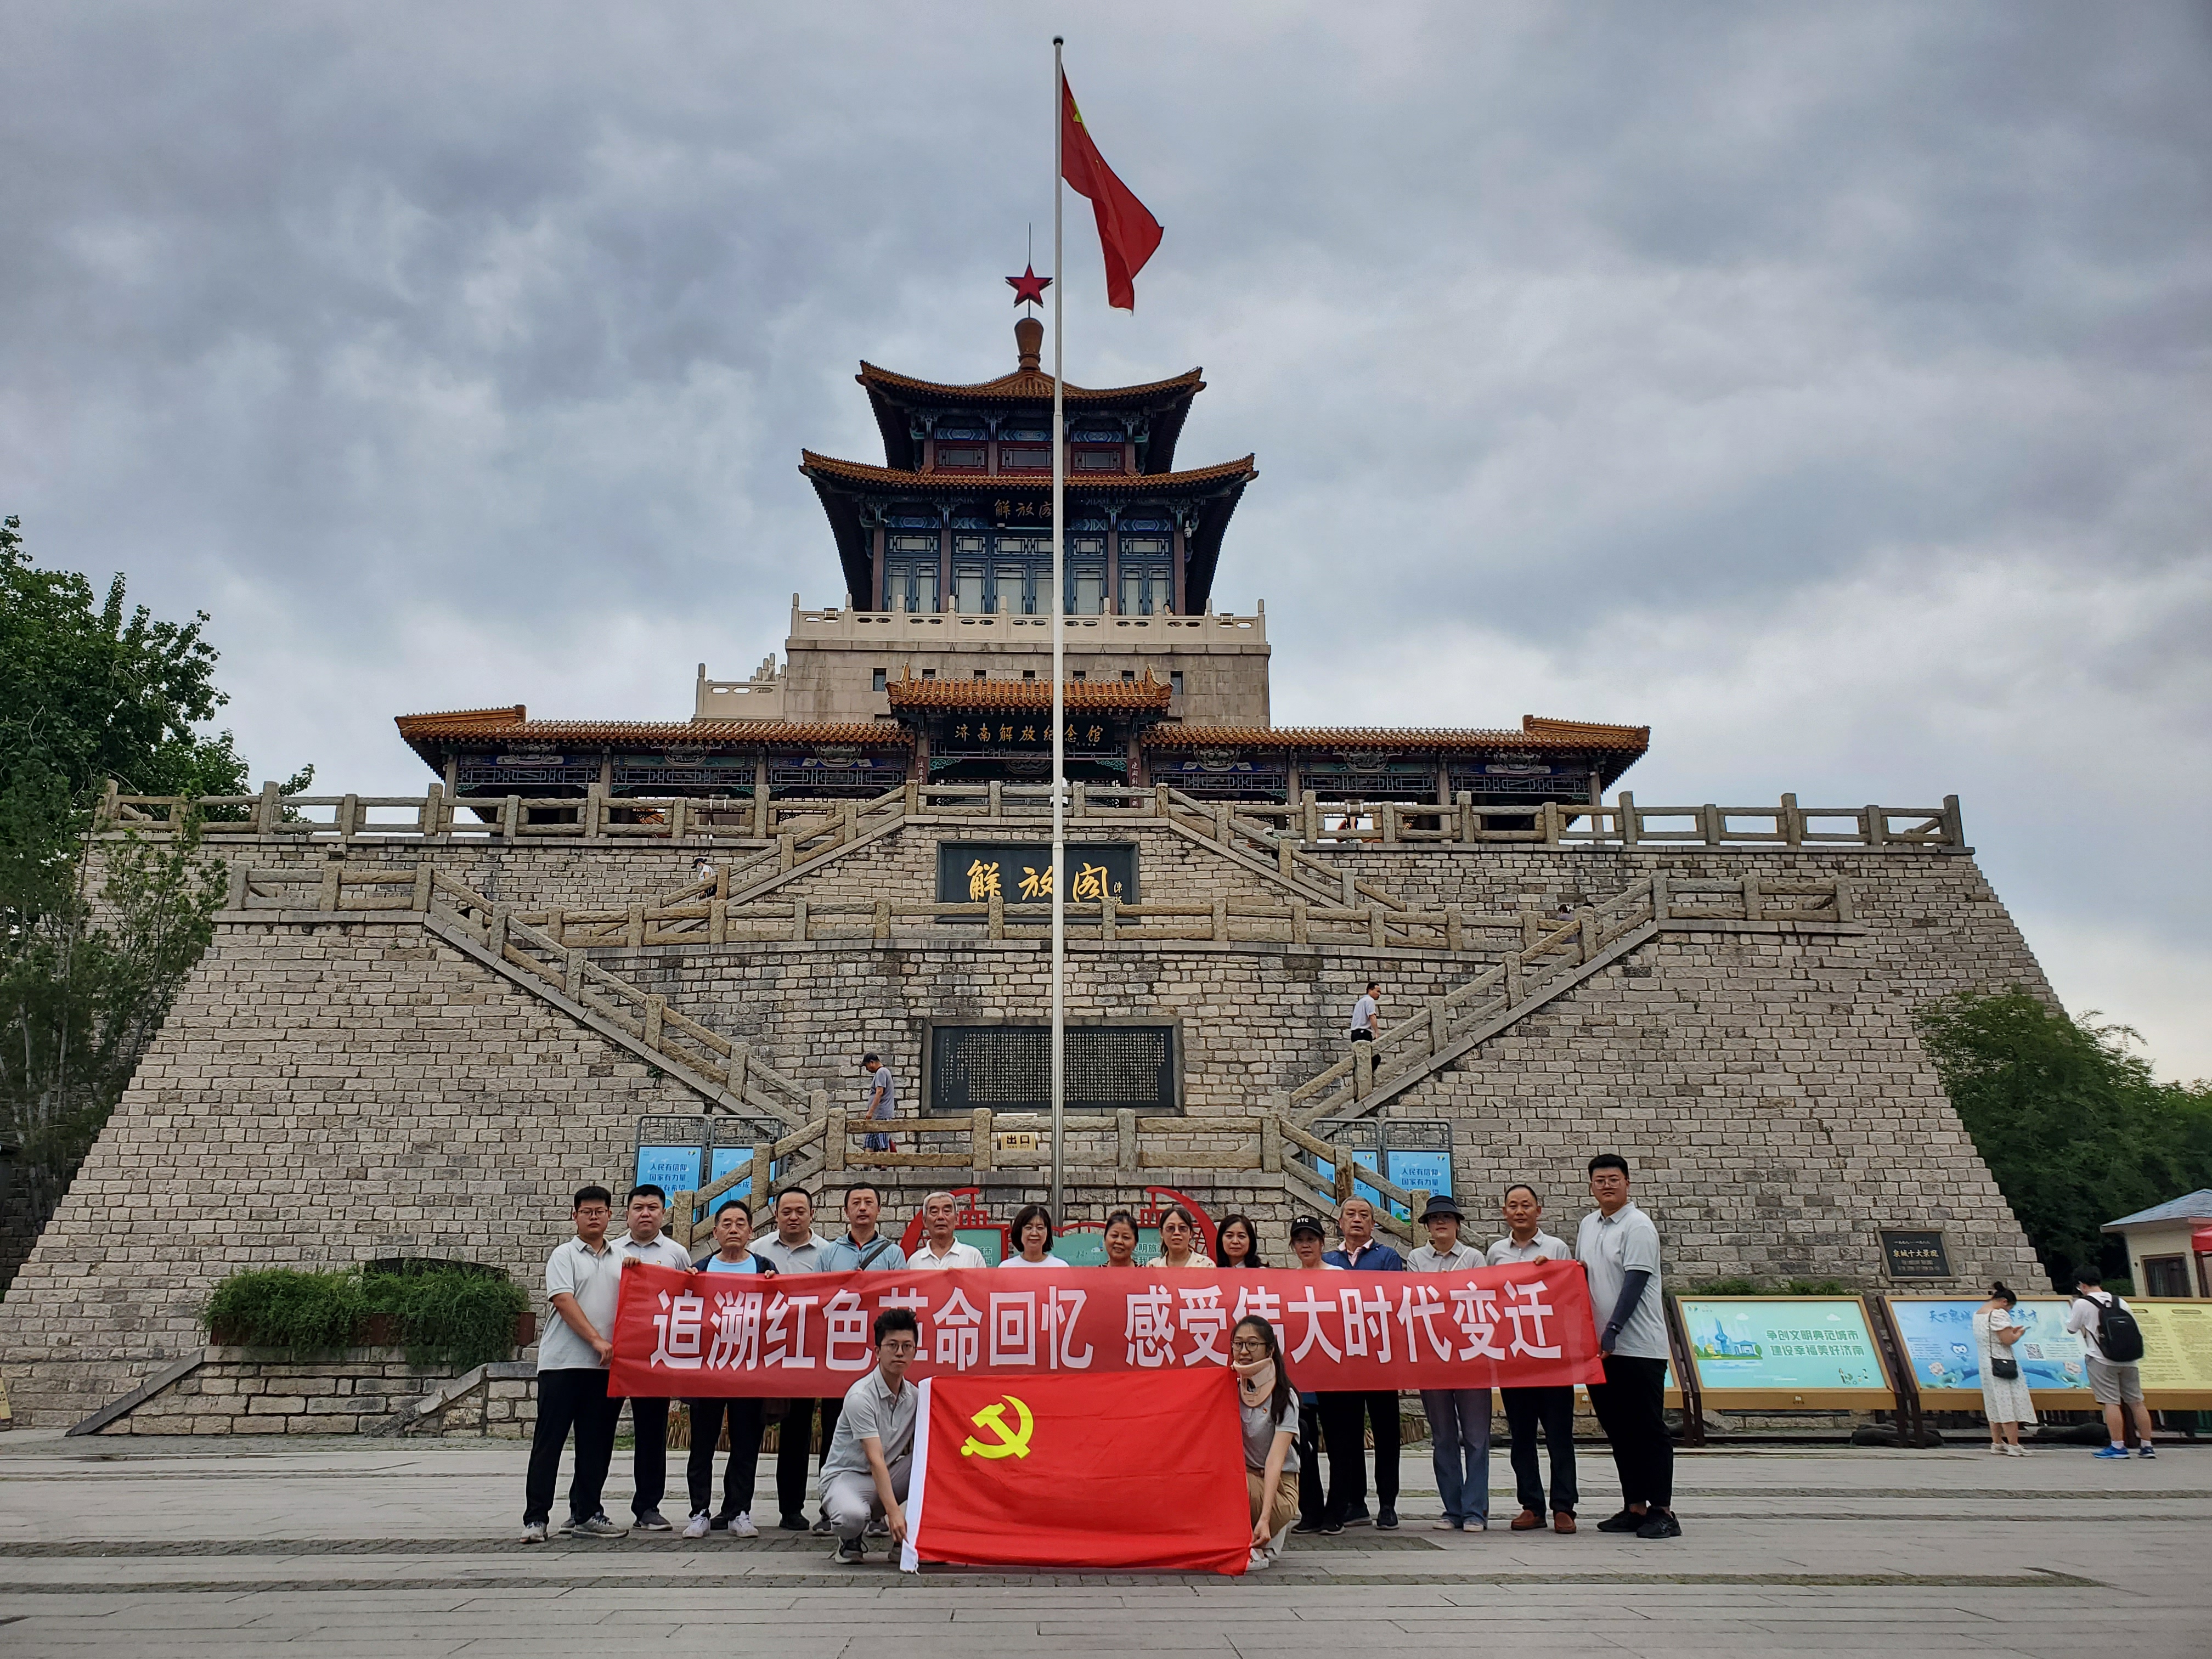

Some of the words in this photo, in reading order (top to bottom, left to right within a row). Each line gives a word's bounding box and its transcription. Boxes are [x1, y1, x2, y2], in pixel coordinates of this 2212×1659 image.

[955, 723, 1103, 743] 济南解放纪念馆
[967, 859, 1109, 902] 解放阁
[1007, 1134, 1030, 1144] 出口
[650, 1163, 687, 1171] 人民有信仰
[1135, 1243, 1160, 1253] 明旅
[1125, 1280, 1562, 1367] 感受伟大时代变迁
[1767, 1330, 1859, 1341] 争创文明典范城市
[1770, 1345, 1865, 1356] 建设幸福美好济南
